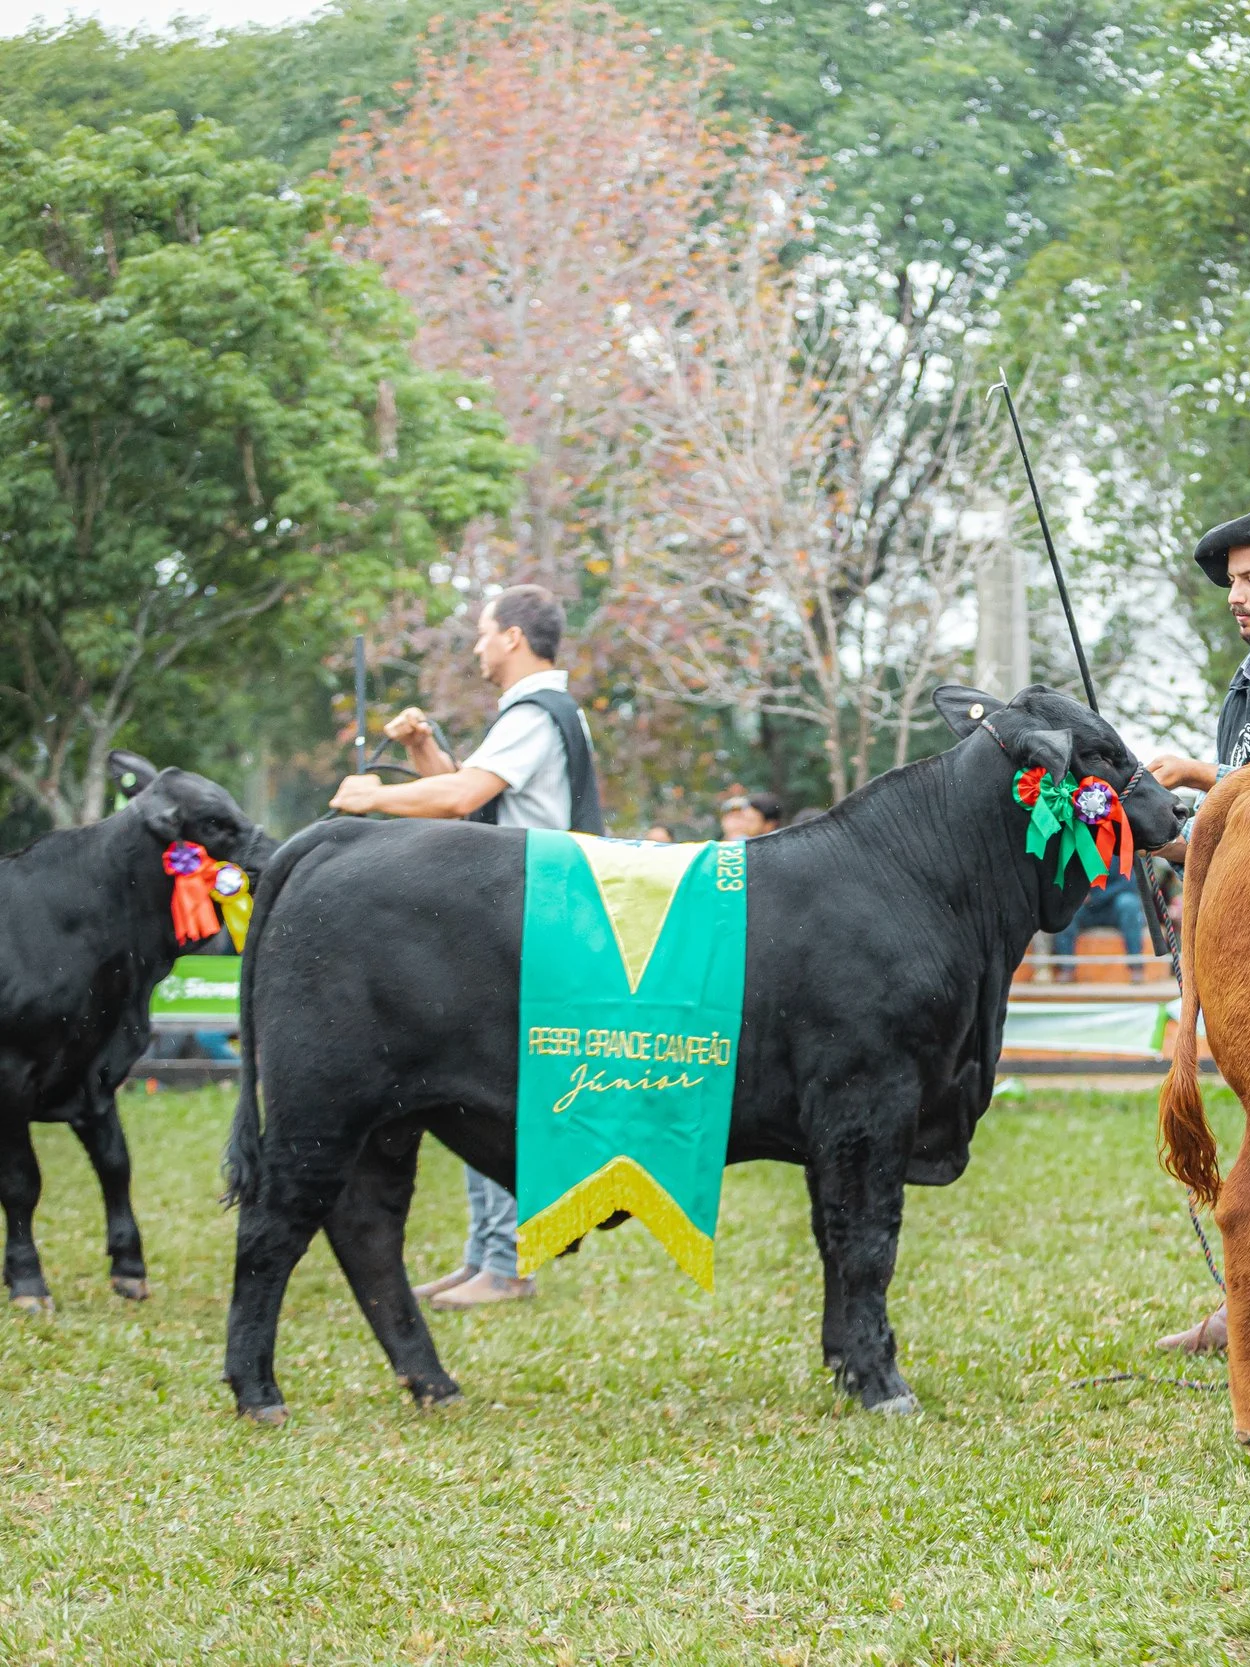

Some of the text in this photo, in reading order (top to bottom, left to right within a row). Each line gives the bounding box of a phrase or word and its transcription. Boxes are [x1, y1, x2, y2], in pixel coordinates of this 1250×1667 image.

[716, 848, 744, 891] 2023
[585, 1029, 653, 1061] GRANDE
[655, 1031, 732, 1066] CAMPEÃO
[552, 1063, 704, 1113] Júnior
